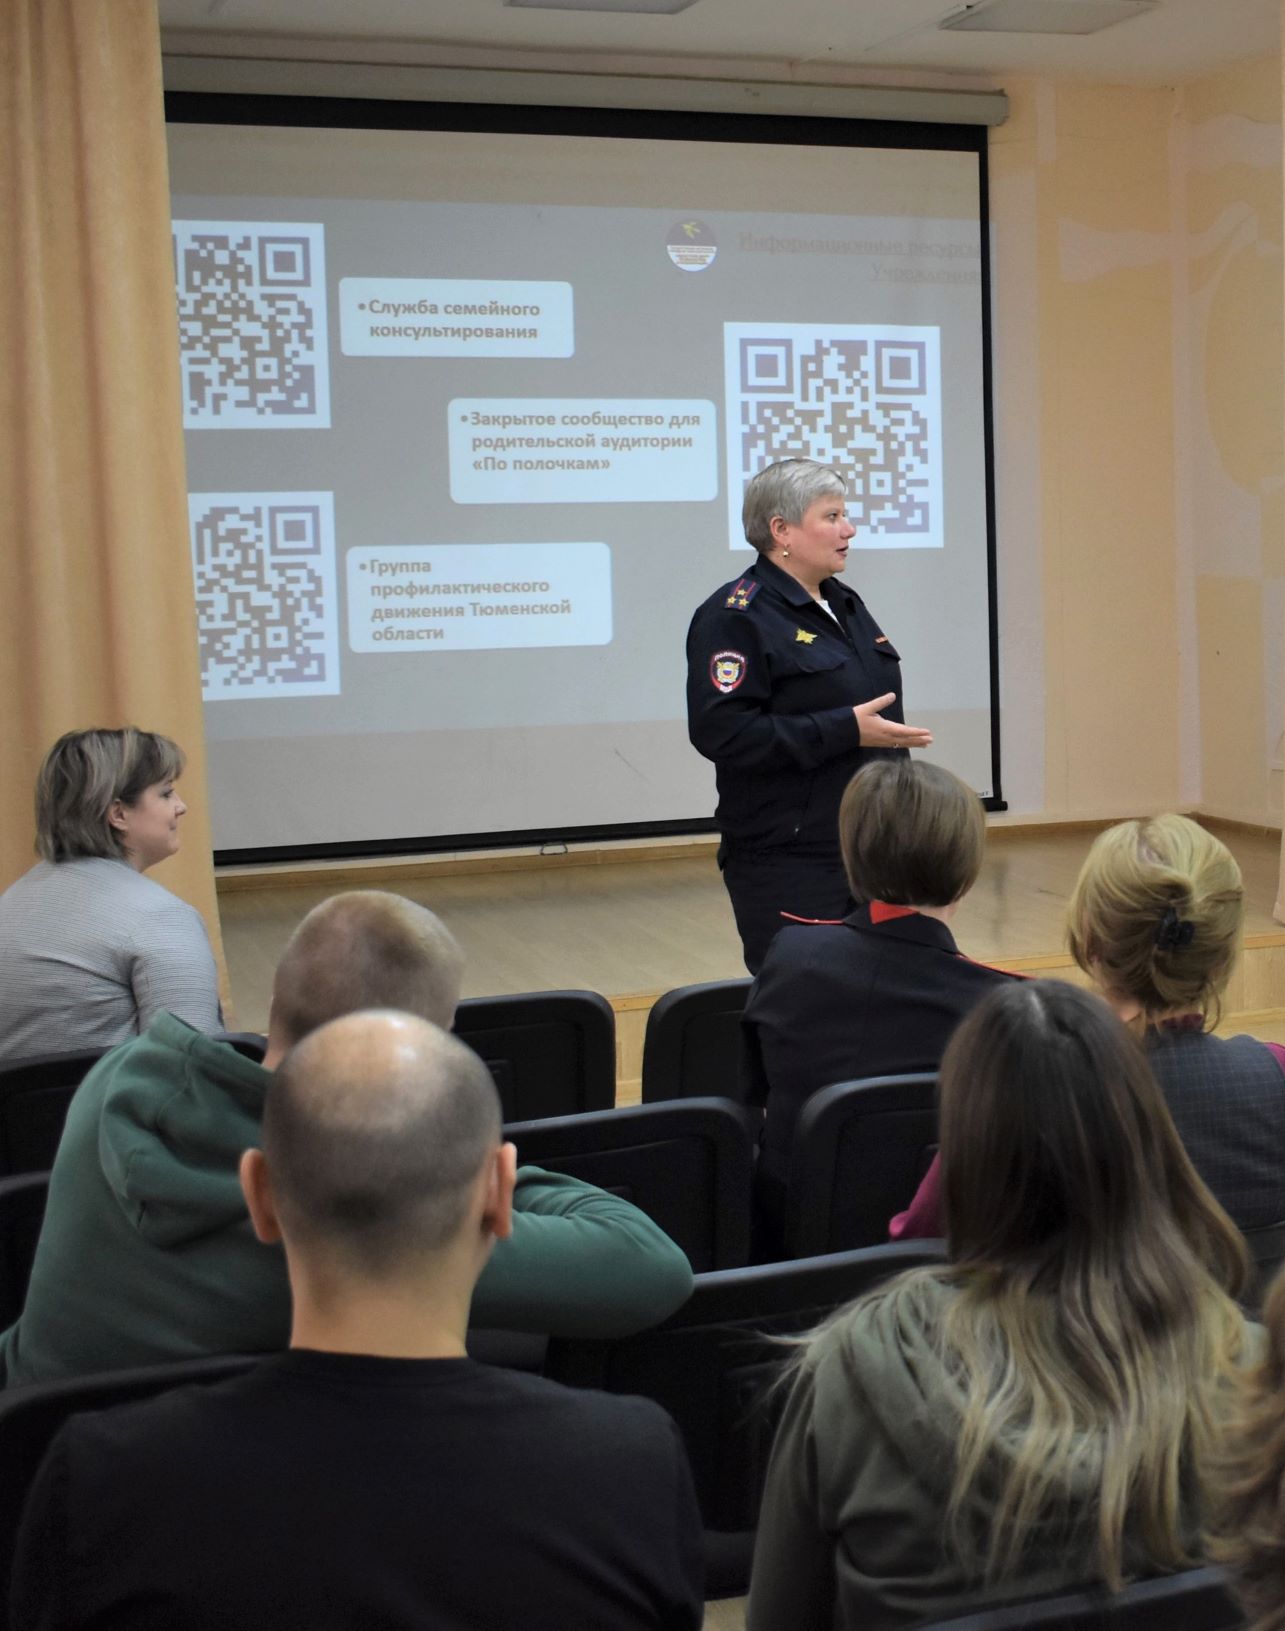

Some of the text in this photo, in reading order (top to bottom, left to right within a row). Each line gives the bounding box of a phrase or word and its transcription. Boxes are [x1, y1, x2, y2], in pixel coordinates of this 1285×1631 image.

[369, 299, 541, 316] Служба семейного
[370, 325, 538, 340] консультирования
[471, 410, 700, 428] Закрытое сообщество для
[472, 432, 694, 450] родительской аудитории
[473, 456, 611, 471] «По полочкам»
[370, 559, 431, 574] Группа
[371, 580, 550, 599] профилактического
[371, 600, 571, 622] движения Тюменской
[372, 626, 444, 641] области
